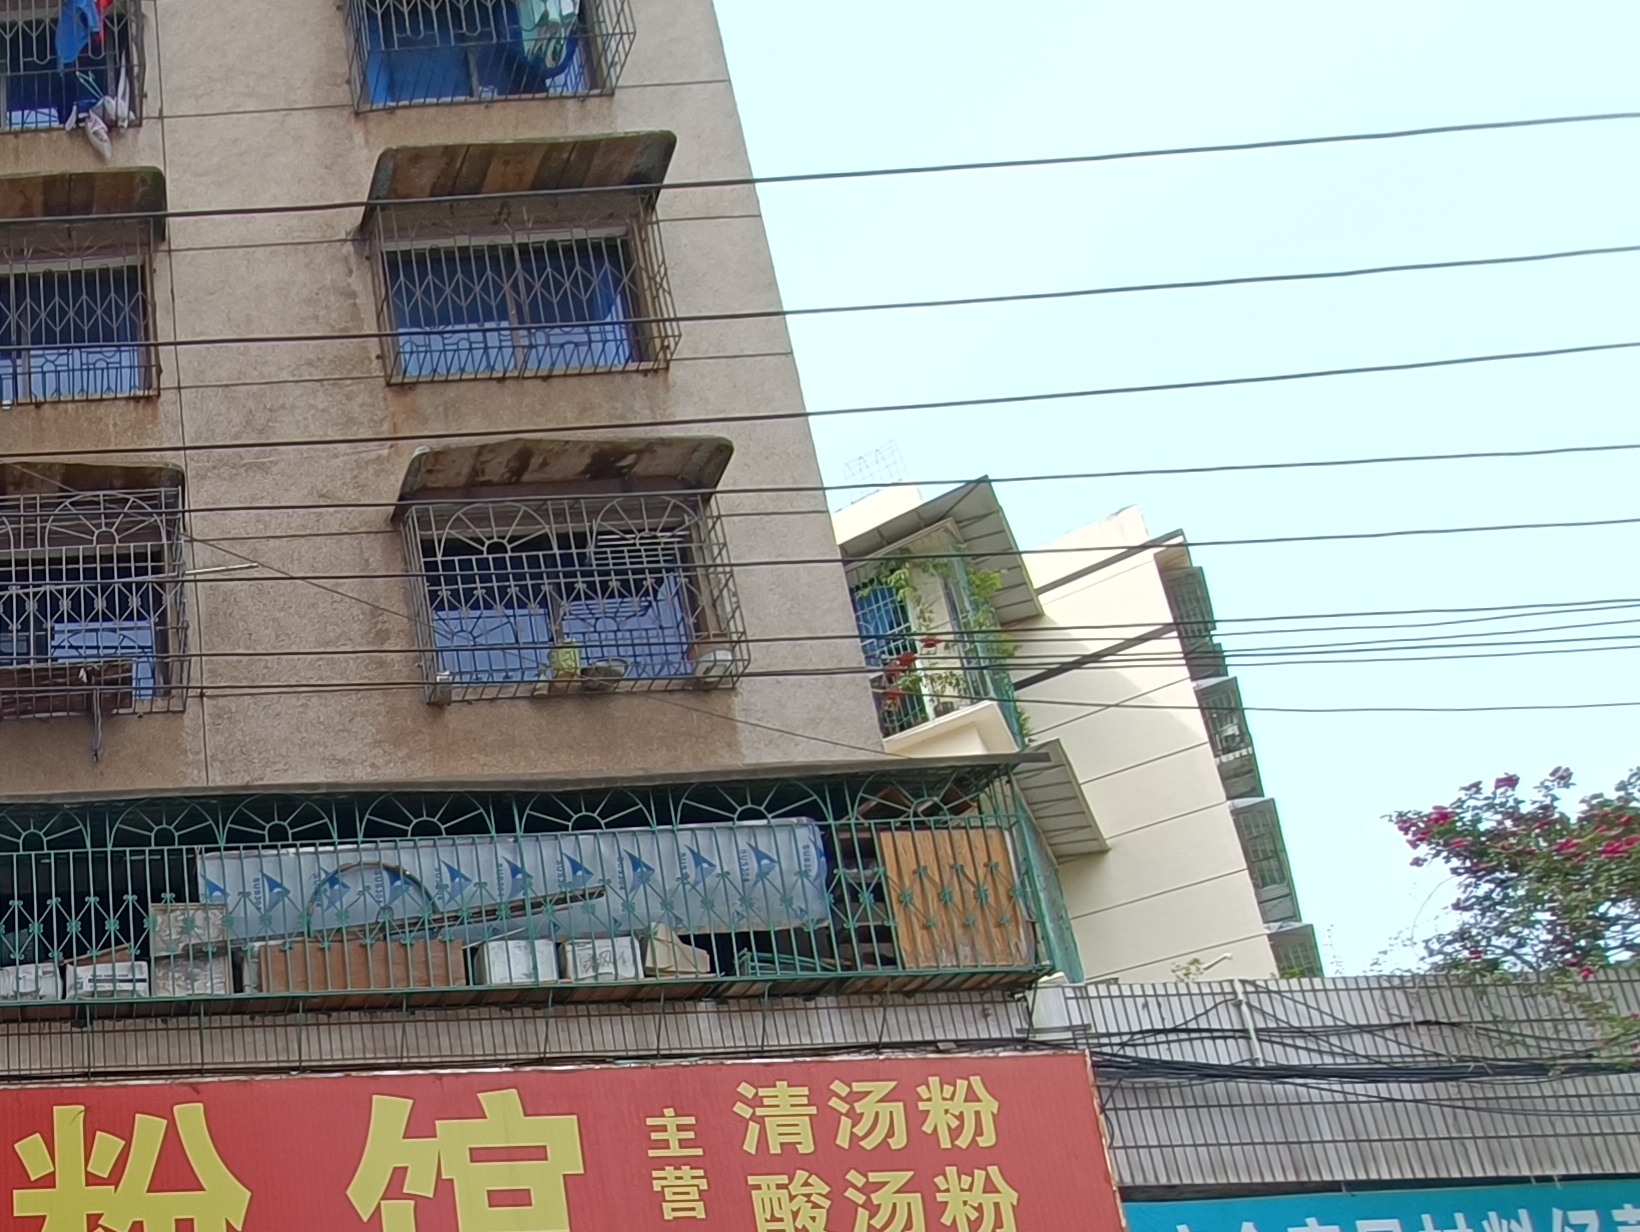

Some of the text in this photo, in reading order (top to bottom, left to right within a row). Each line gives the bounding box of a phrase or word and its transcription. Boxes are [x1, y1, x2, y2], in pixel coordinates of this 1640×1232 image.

[732, 1075, 1000, 1156] 清汤粉
[645, 1108, 709, 1221] 主营
